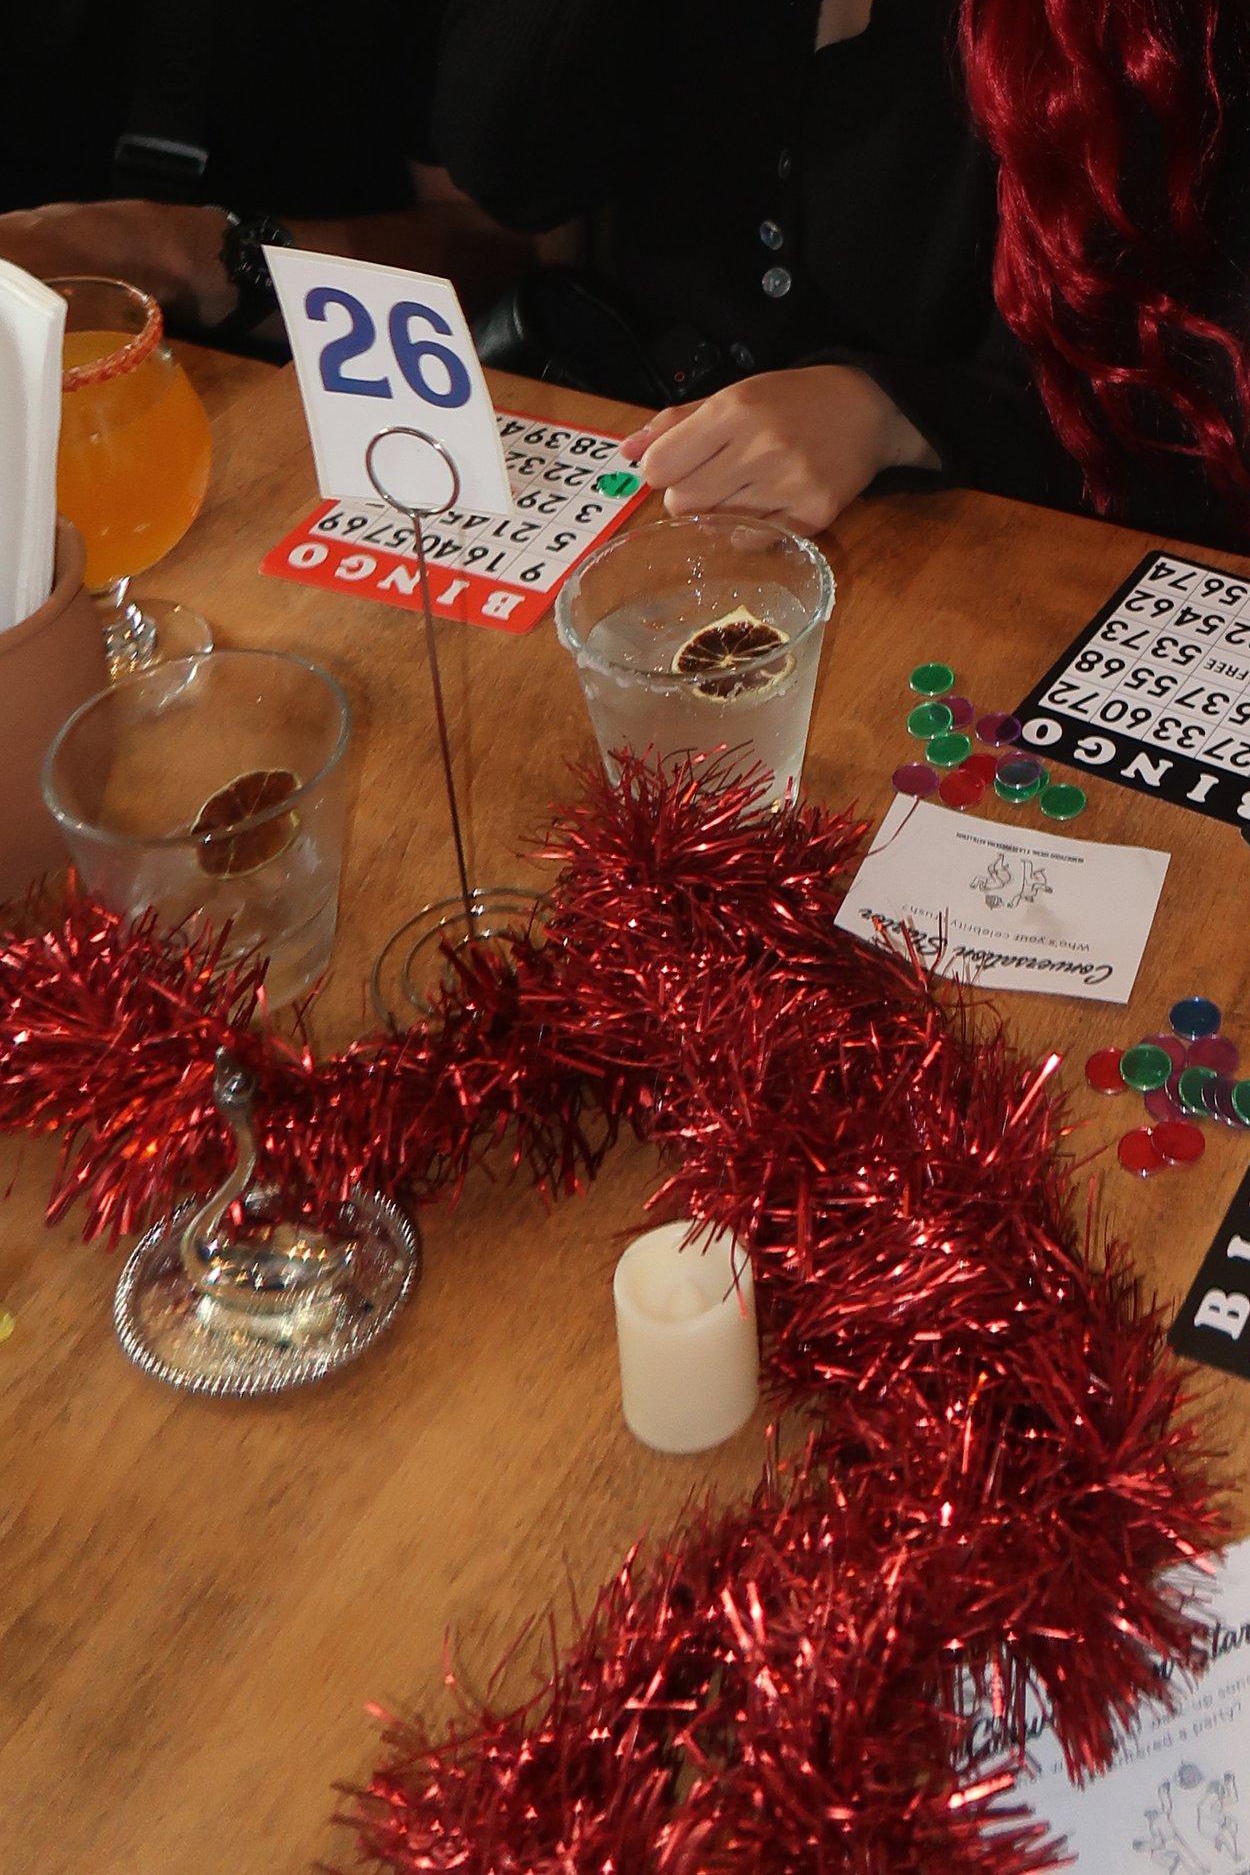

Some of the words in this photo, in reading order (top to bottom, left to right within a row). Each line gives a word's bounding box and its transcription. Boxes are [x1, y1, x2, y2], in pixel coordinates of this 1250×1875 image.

[304, 285, 472, 409] 26
[523, 426, 572, 450] 39
[568, 436, 619, 461] 28
[542, 460, 595, 488] 22
[516, 489, 569, 515] 29
[574, 502, 603, 525] 3
[317, 510, 369, 537] 69
[361, 522, 417, 549] 57
[491, 519, 543, 544] 21
[411, 532, 463, 560] 40
[545, 530, 578, 553] 5
[462, 545, 507, 573] 16
[518, 561, 546, 583] 9
[286, 541, 527, 620] BINGO
[1147, 561, 1198, 592] 74
[1123, 589, 1175, 619] 62
[1199, 578, 1248, 606] 56
[1172, 606, 1226, 636] 54
[1099, 620, 1151, 651] 73
[1073, 649, 1126, 679] 68
[1149, 636, 1202, 666] 53
[1122, 667, 1178, 698] 55
[1202, 658, 1250, 681] FREE
[1046, 680, 1100, 715] 72
[1173, 686, 1230, 716] 37
[1098, 699, 1152, 730] 60
[1151, 717, 1206, 749] 33
[950, 918, 1010, 940] celebrity
[1013, 932, 1046, 946] your
[951, 943, 1114, 986] Conversation
